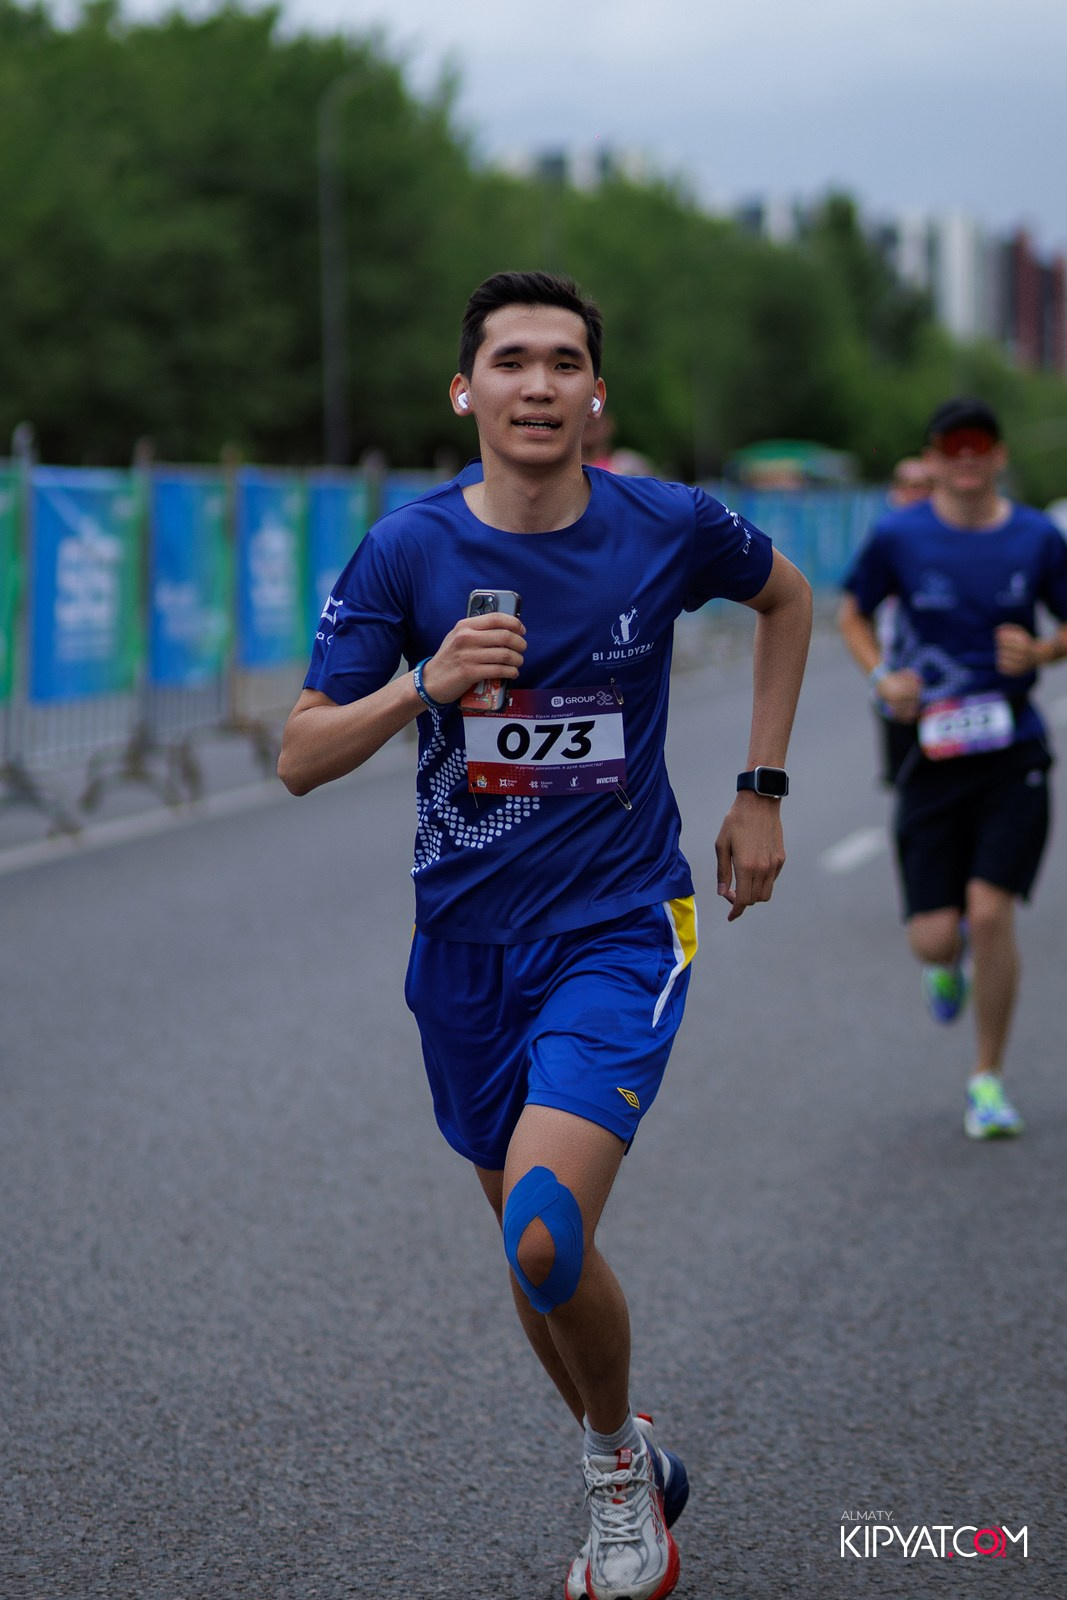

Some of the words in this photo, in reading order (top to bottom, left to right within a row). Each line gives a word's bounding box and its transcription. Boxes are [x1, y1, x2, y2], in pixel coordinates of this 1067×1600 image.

[592, 652, 604, 661] BI
[565, 695, 596, 705] GROUP
[497, 720, 596, 761] 073
